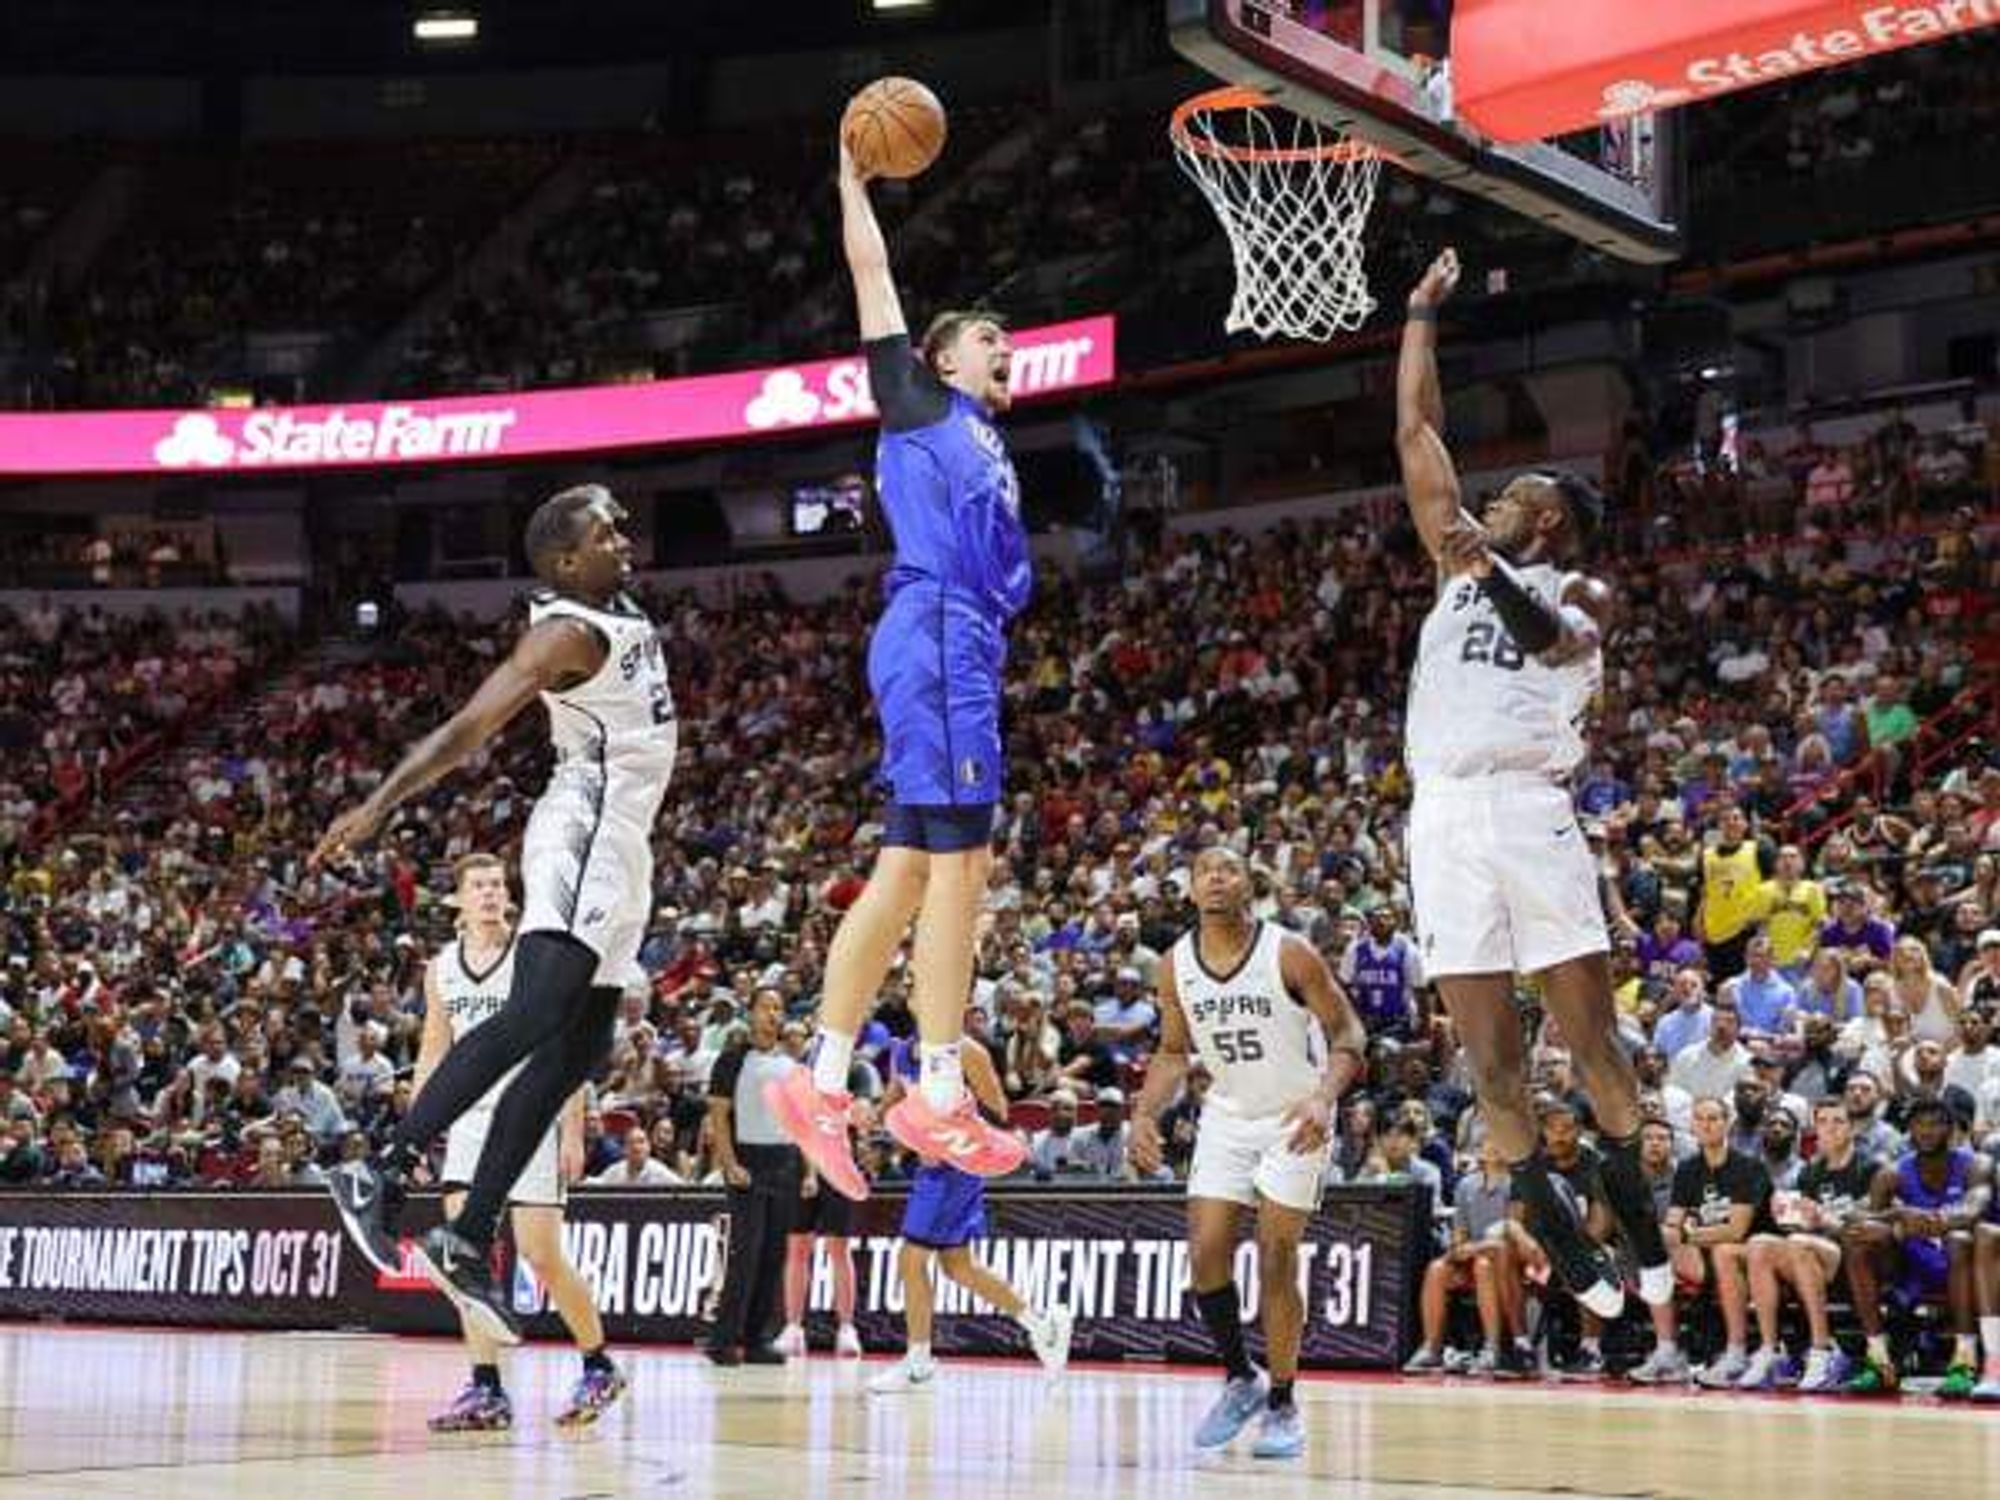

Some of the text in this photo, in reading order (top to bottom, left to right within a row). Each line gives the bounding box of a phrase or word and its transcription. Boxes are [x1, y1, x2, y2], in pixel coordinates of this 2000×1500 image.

[1212, 1029, 1264, 1064] 55
[19, 1227, 188, 1294] TOURNAMENT
[190, 1229, 249, 1295] TIPS
[250, 1230, 309, 1297] OCT
[308, 1230, 341, 1298] 31
[633, 1221, 717, 1317] CUP
[1132, 1239, 1201, 1321] TIP
[1233, 1241, 1318, 1325] OT
[1325, 1242, 1372, 1327] 31
